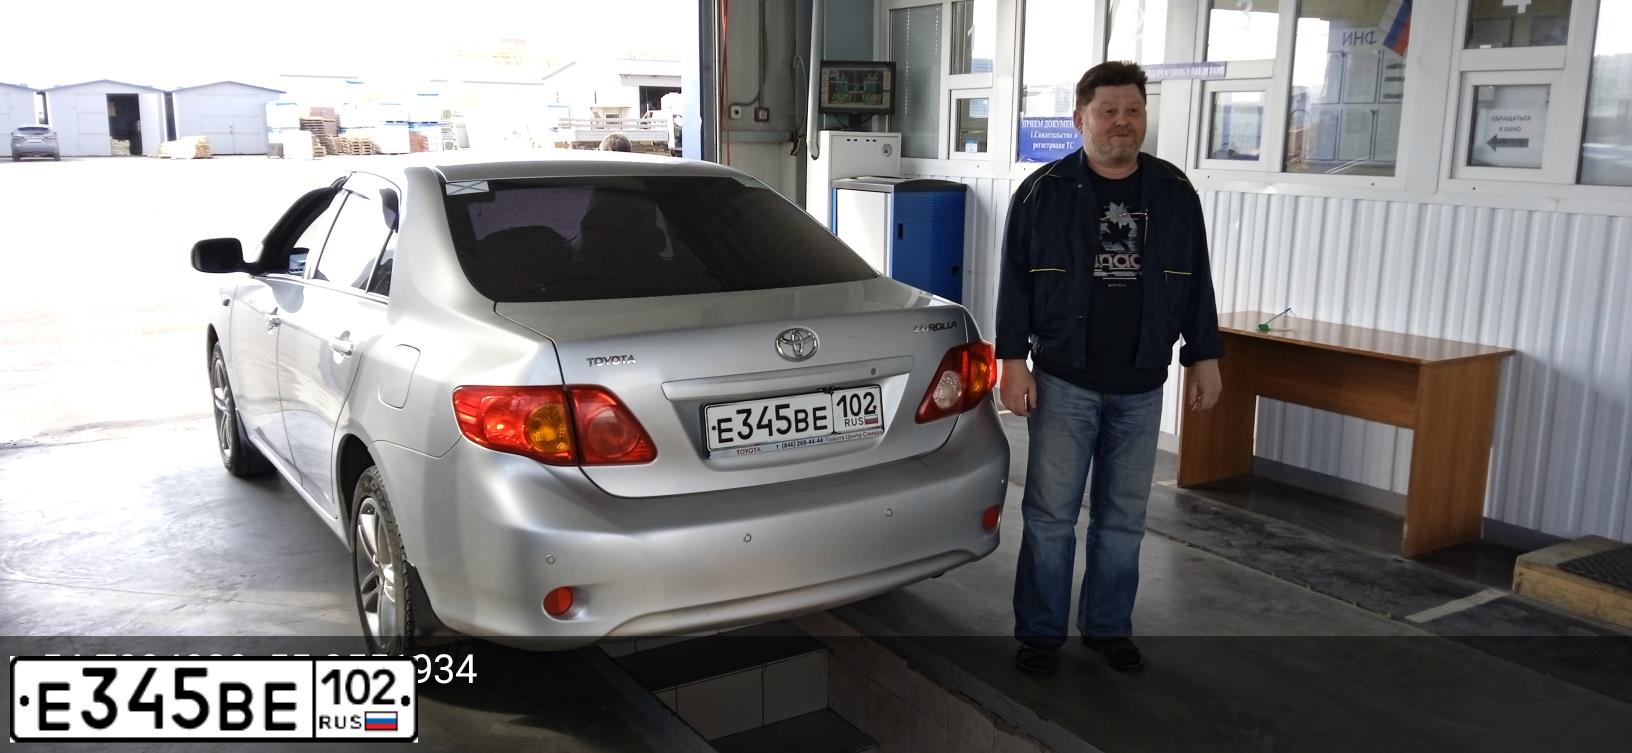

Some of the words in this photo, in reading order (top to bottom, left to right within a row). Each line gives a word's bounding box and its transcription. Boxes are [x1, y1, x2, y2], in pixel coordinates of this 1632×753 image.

[586, 354, 636, 367] TOYOTA
[836, 391, 877, 417] 102
[844, 416, 864, 427] RUS
[736, 447, 761, 455] TOYOTA
